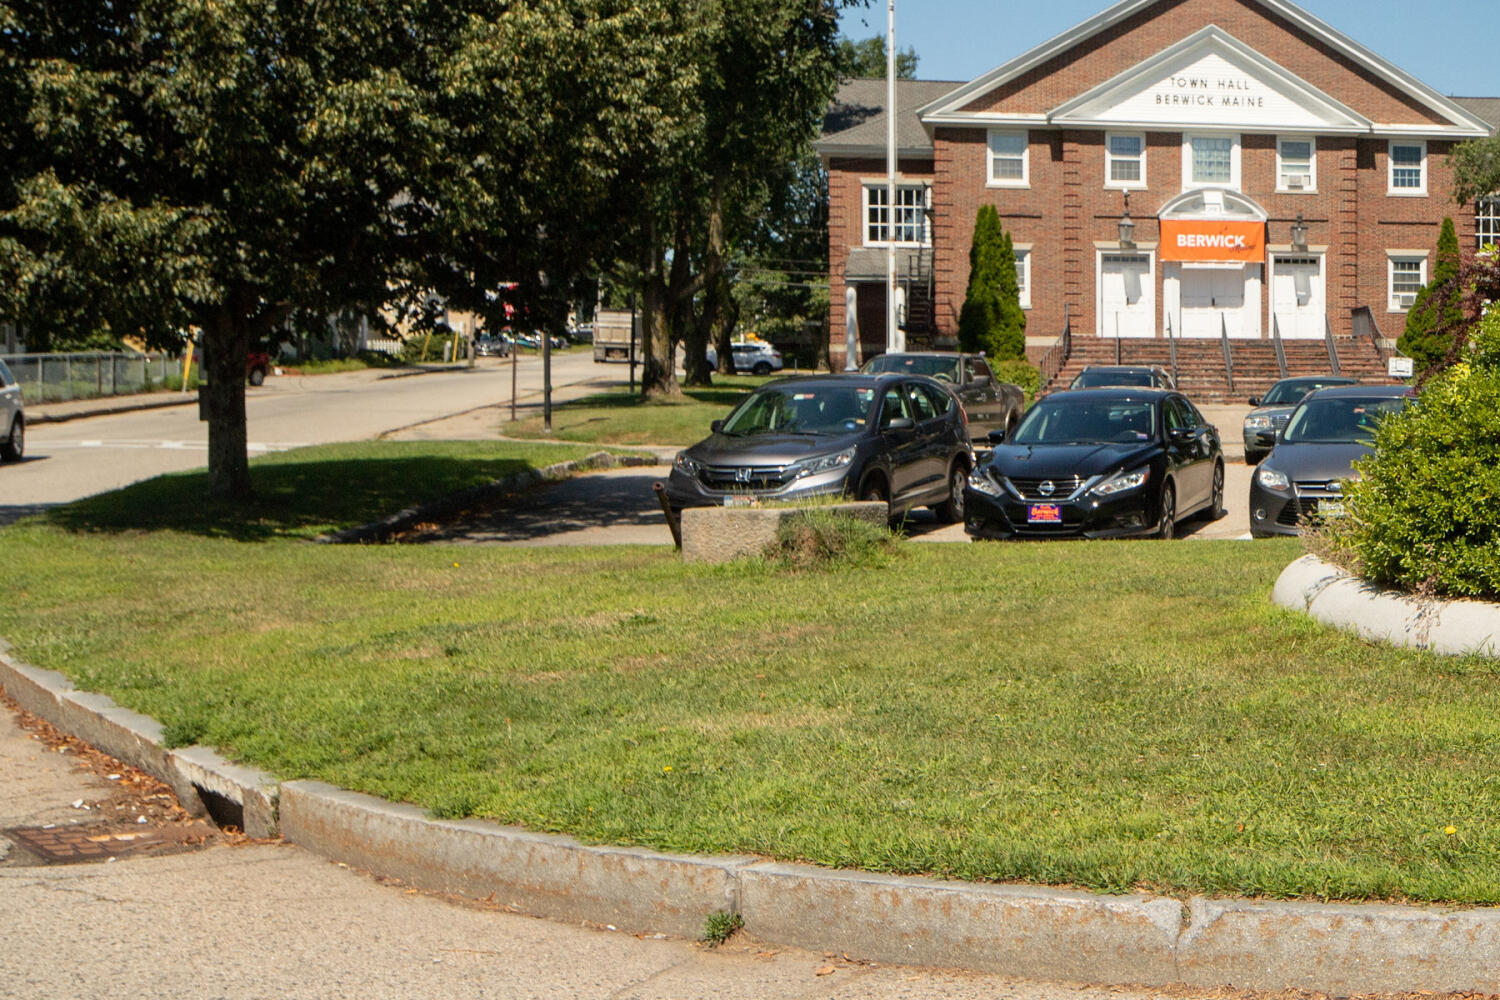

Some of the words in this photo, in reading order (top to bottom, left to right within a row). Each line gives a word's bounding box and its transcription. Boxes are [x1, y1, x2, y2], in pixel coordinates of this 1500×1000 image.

[1171, 77, 1208, 88] TOWN
[1218, 79, 1250, 90] HALL
[1156, 94, 1214, 106] BERWICK
[1222, 96, 1264, 108] MAINE
[1176, 234, 1245, 248] BERWICK
